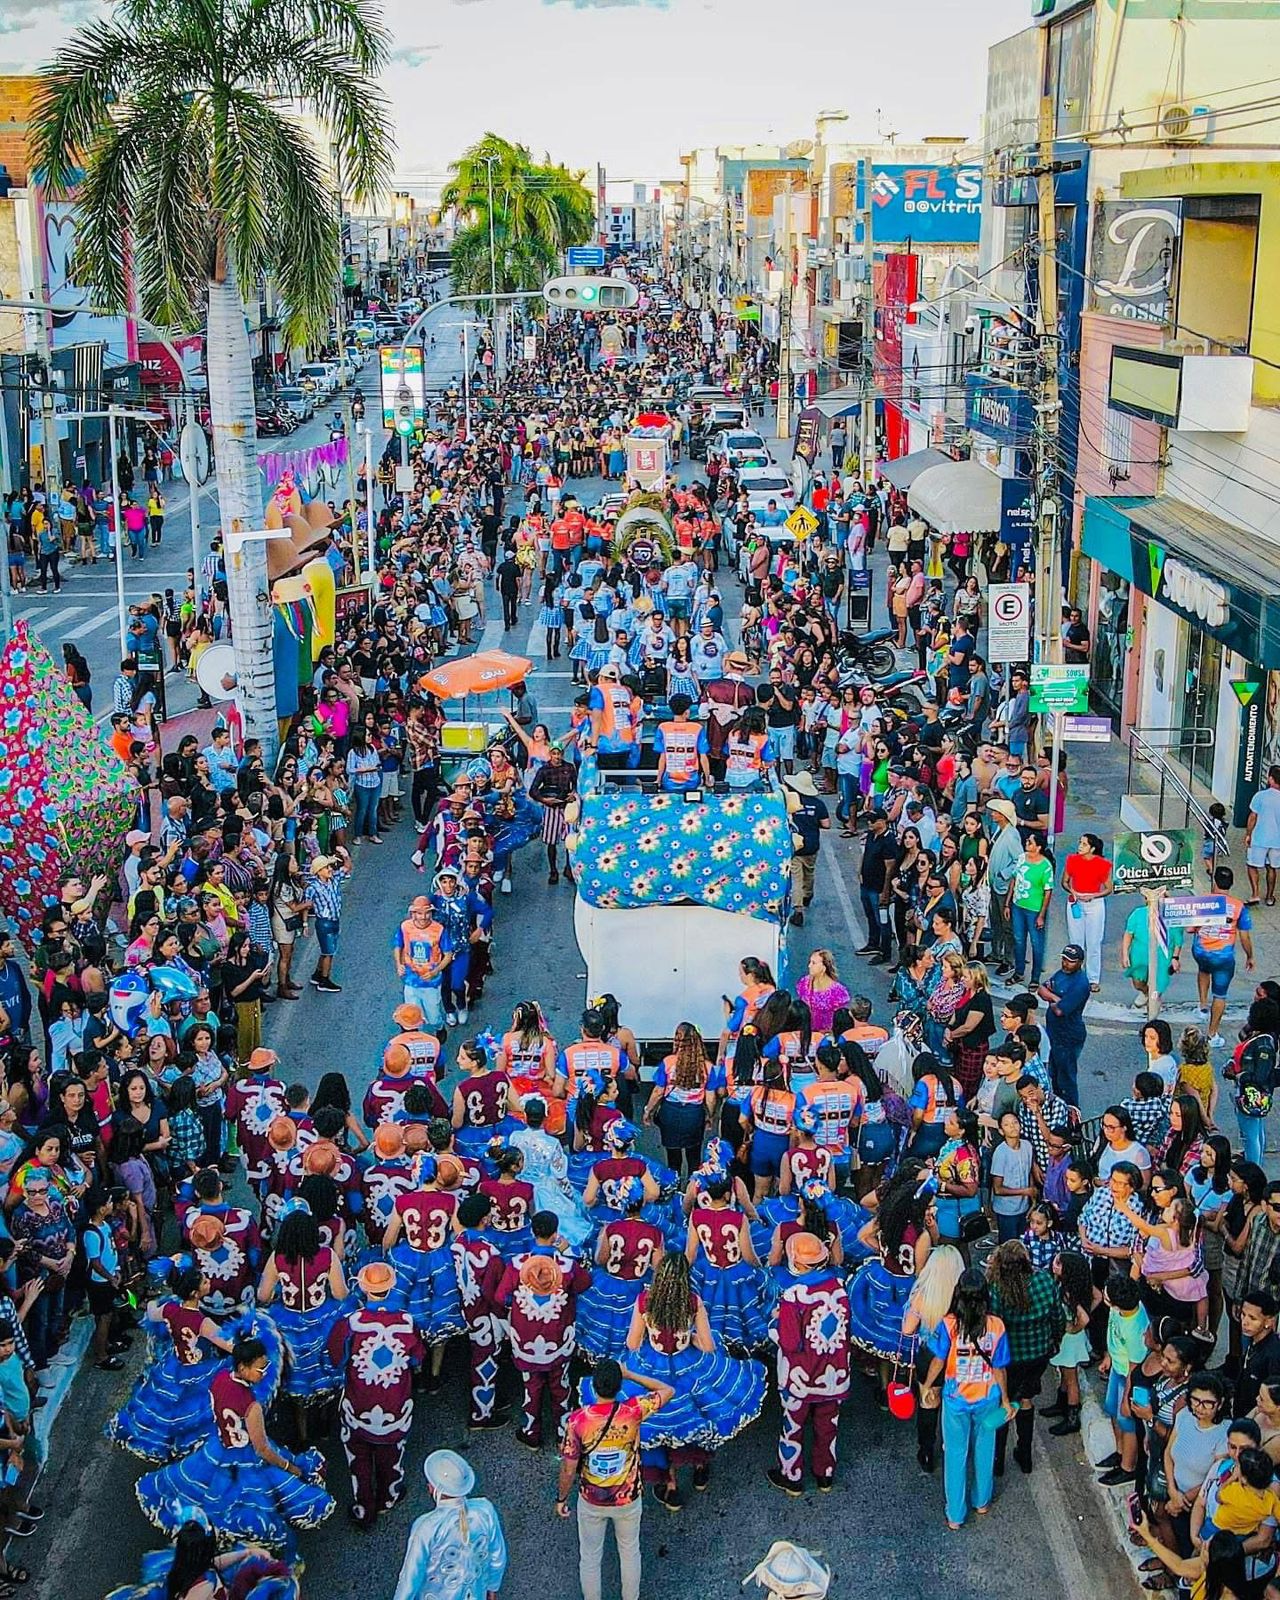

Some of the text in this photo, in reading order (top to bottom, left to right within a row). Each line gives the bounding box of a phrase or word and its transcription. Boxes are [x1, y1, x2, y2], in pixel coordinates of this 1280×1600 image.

[904, 169, 981, 199] FL S
[1003, 600, 1015, 615] E
[1115, 862, 1191, 879] Ótica Visual
